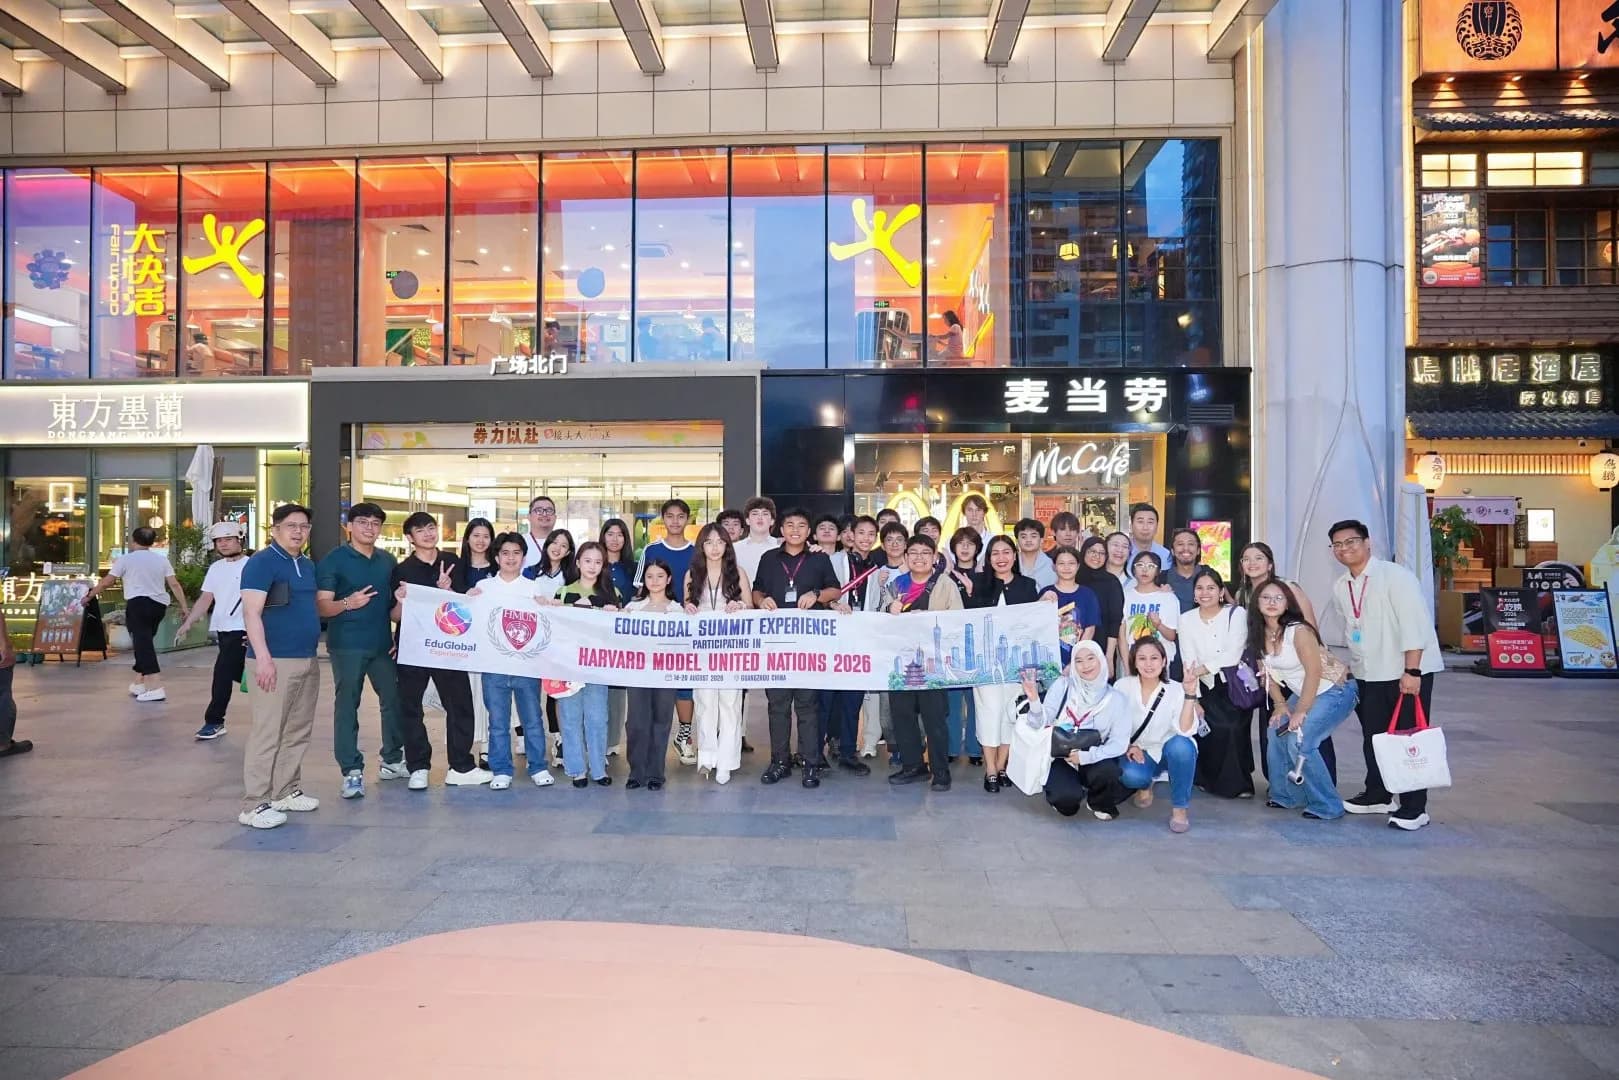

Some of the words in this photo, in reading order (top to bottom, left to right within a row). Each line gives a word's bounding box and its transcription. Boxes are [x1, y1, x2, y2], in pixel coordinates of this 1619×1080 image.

[122, 223, 166, 316] 大快活
[490, 354, 568, 375] 广场北门
[1004, 377, 1168, 414] 麦当劳
[1029, 442, 1130, 485] McCafé
[503, 609, 537, 622] HMUN
[1130, 603, 1146, 616] RIO
[615, 617, 692, 638] EDUGLOBAL
[698, 618, 754, 637] SUMMIT
[759, 616, 837, 636] EXPERIENCE
[424, 638, 477, 652] EduGlobal
[692, 638, 749, 650] PARTICIPATING
[752, 638, 761, 649] IN
[430, 648, 469, 659] Experience
[578, 647, 646, 670] HARVARD
[652, 652, 702, 672] MODEL
[708, 652, 760, 672] UNITED
[766, 652, 827, 673] NATIONS
[833, 654, 871, 673] 2026
[689, 674, 709, 682] AUGUST
